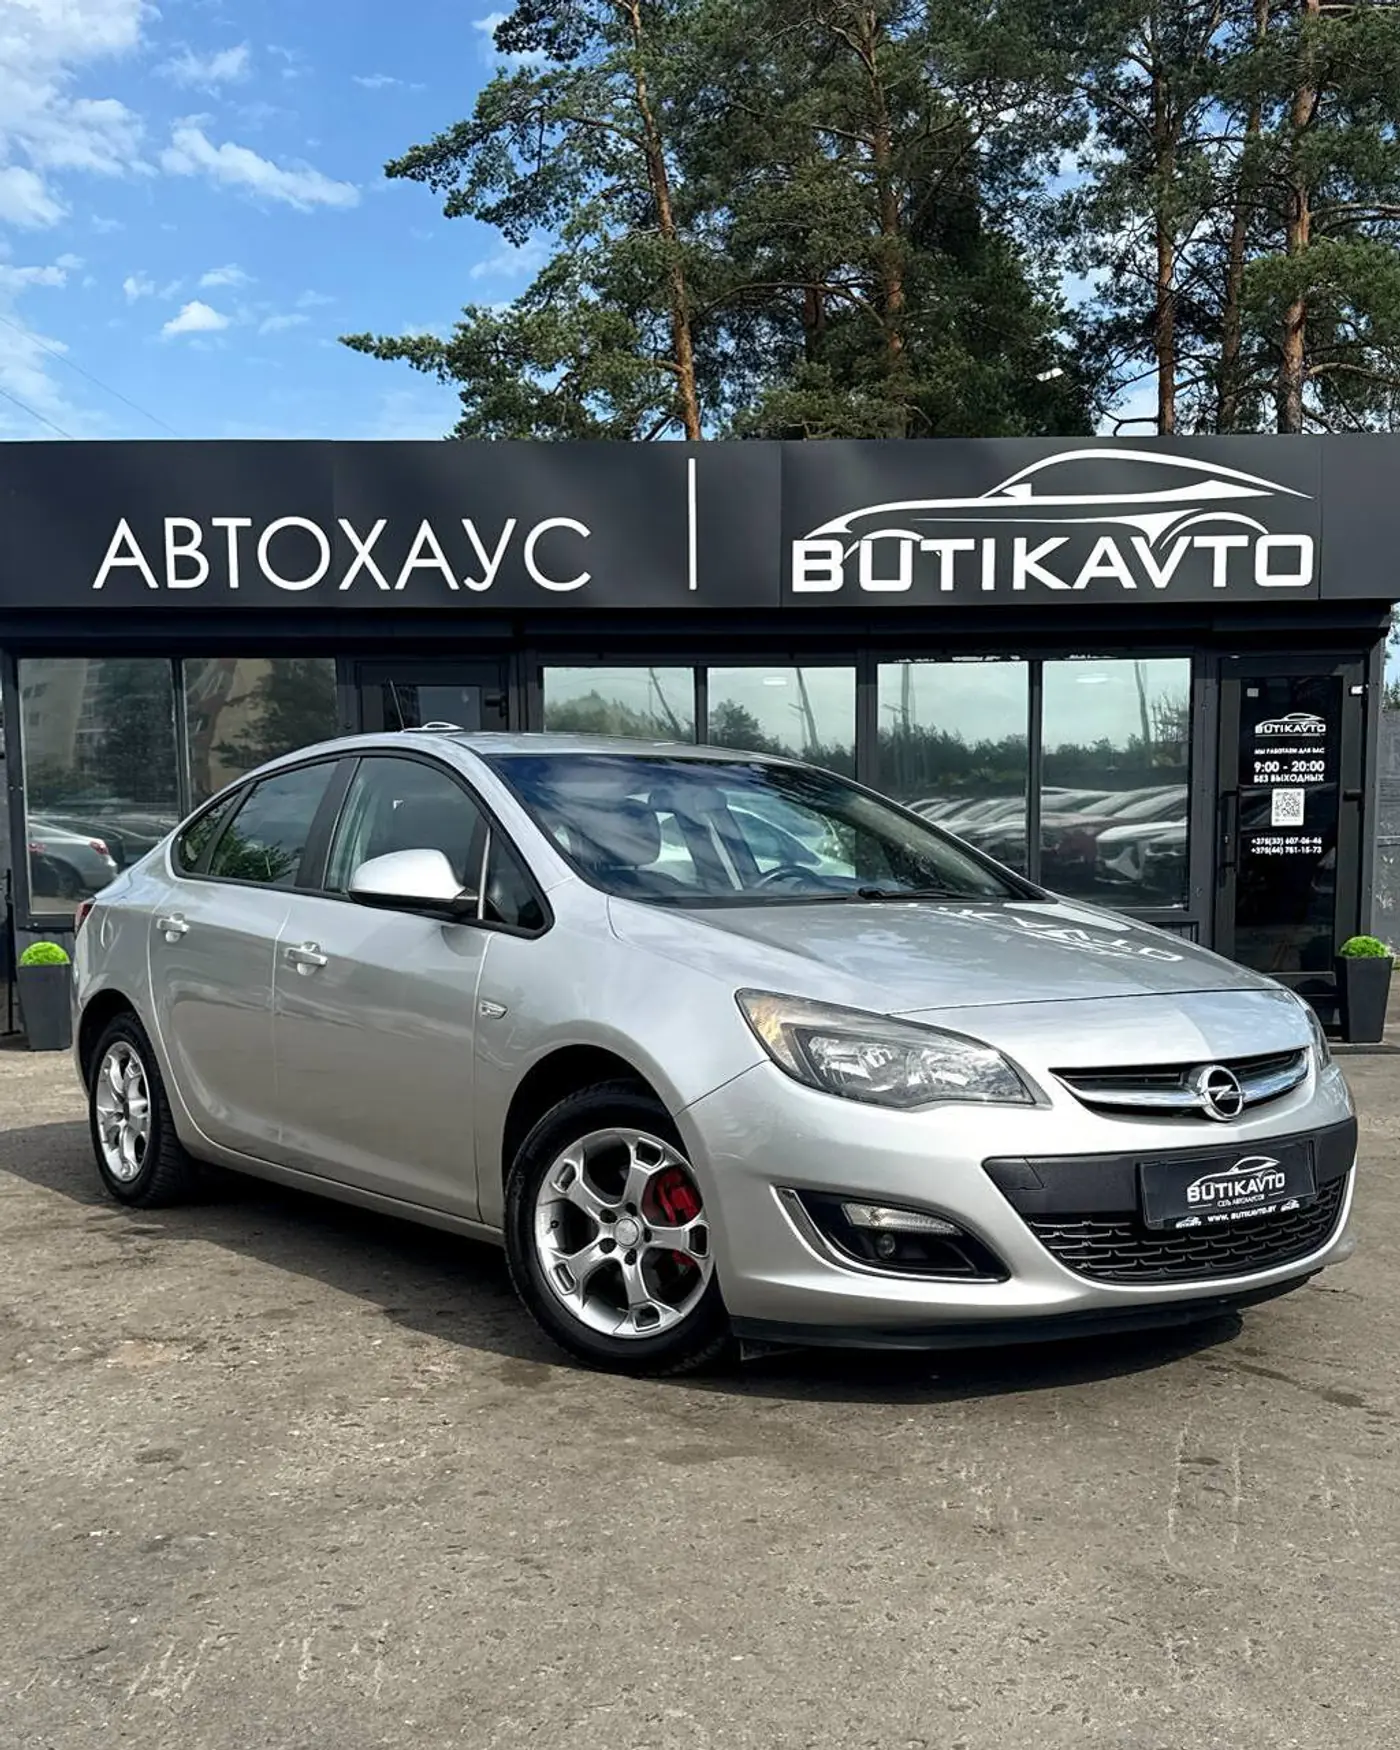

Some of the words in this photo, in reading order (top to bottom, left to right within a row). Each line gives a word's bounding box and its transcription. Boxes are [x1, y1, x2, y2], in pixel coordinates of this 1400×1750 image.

[92, 516, 592, 592] АВТОХАУС
[791, 534, 1314, 594] BUTIKAVTO
[1255, 724, 1326, 734] BUTIKAVTO
[1254, 761, 1280, 773] 9:00
[1291, 760, 1325, 773] 20:00
[1254, 773, 1269, 783] БЕЗ
[1270, 773, 1325, 783] ВЫХОДНЫХ
[1187, 1173, 1285, 1202] BUTIKAVTO
